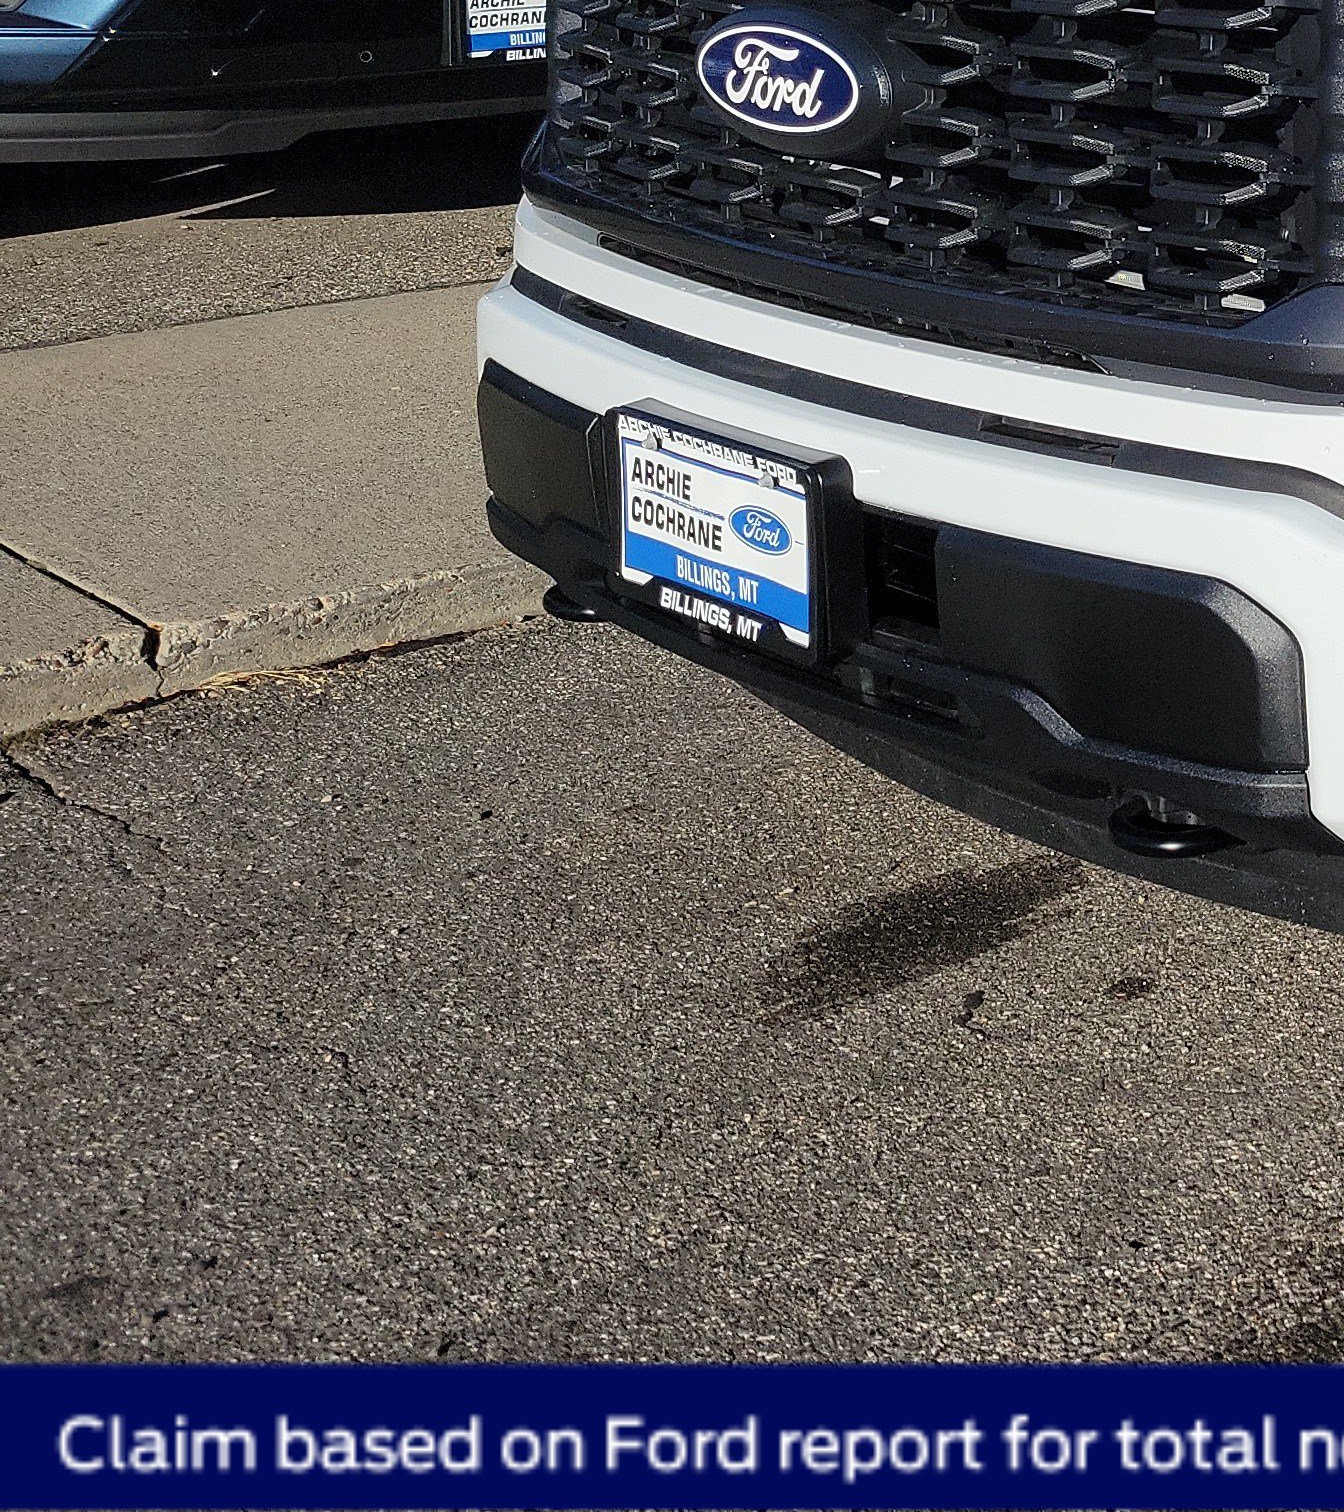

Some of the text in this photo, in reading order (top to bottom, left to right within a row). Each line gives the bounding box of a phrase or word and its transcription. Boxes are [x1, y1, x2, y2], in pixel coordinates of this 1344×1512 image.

[469, 10, 546, 28] COCHRAN
[510, 31, 546, 46] BILLIN
[506, 47, 546, 61] BILLIN
[726, 38, 825, 118] Ford
[631, 456, 692, 502] ARCHIE
[672, 431, 754, 469] COCHRANE
[756, 458, 797, 484] FORD
[631, 495, 723, 552] COCHRANE
[743, 511, 781, 548] Ford
[676, 554, 760, 605] BILLINGS, MT
[660, 586, 763, 642] BILLINGS, MT
